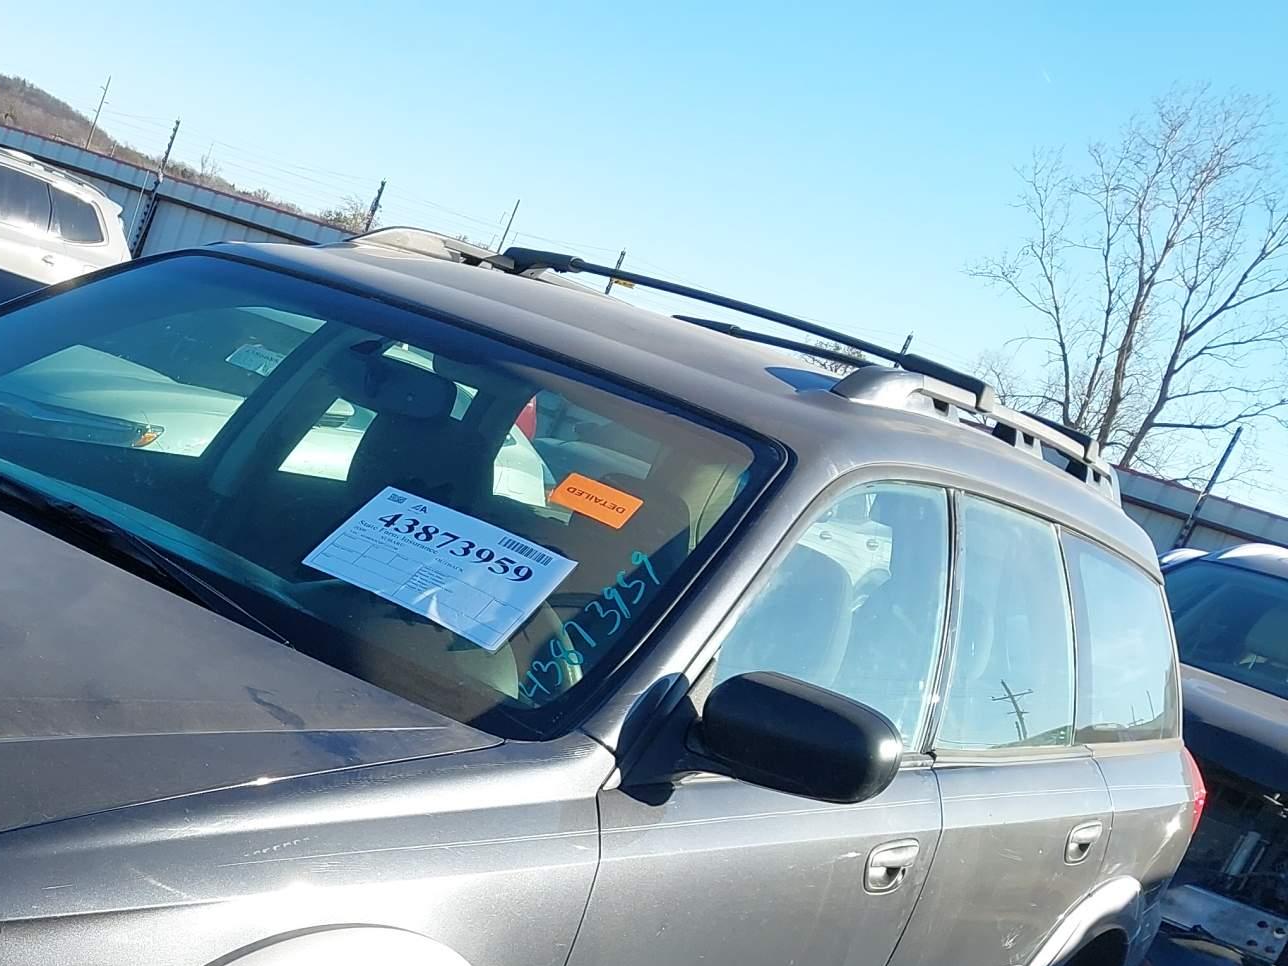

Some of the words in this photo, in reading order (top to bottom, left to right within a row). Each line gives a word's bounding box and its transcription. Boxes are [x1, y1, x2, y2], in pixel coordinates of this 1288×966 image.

[566, 486, 626, 514] DETAILED
[378, 513, 533, 582] 43873959
[518, 551, 661, 698] 43873959
